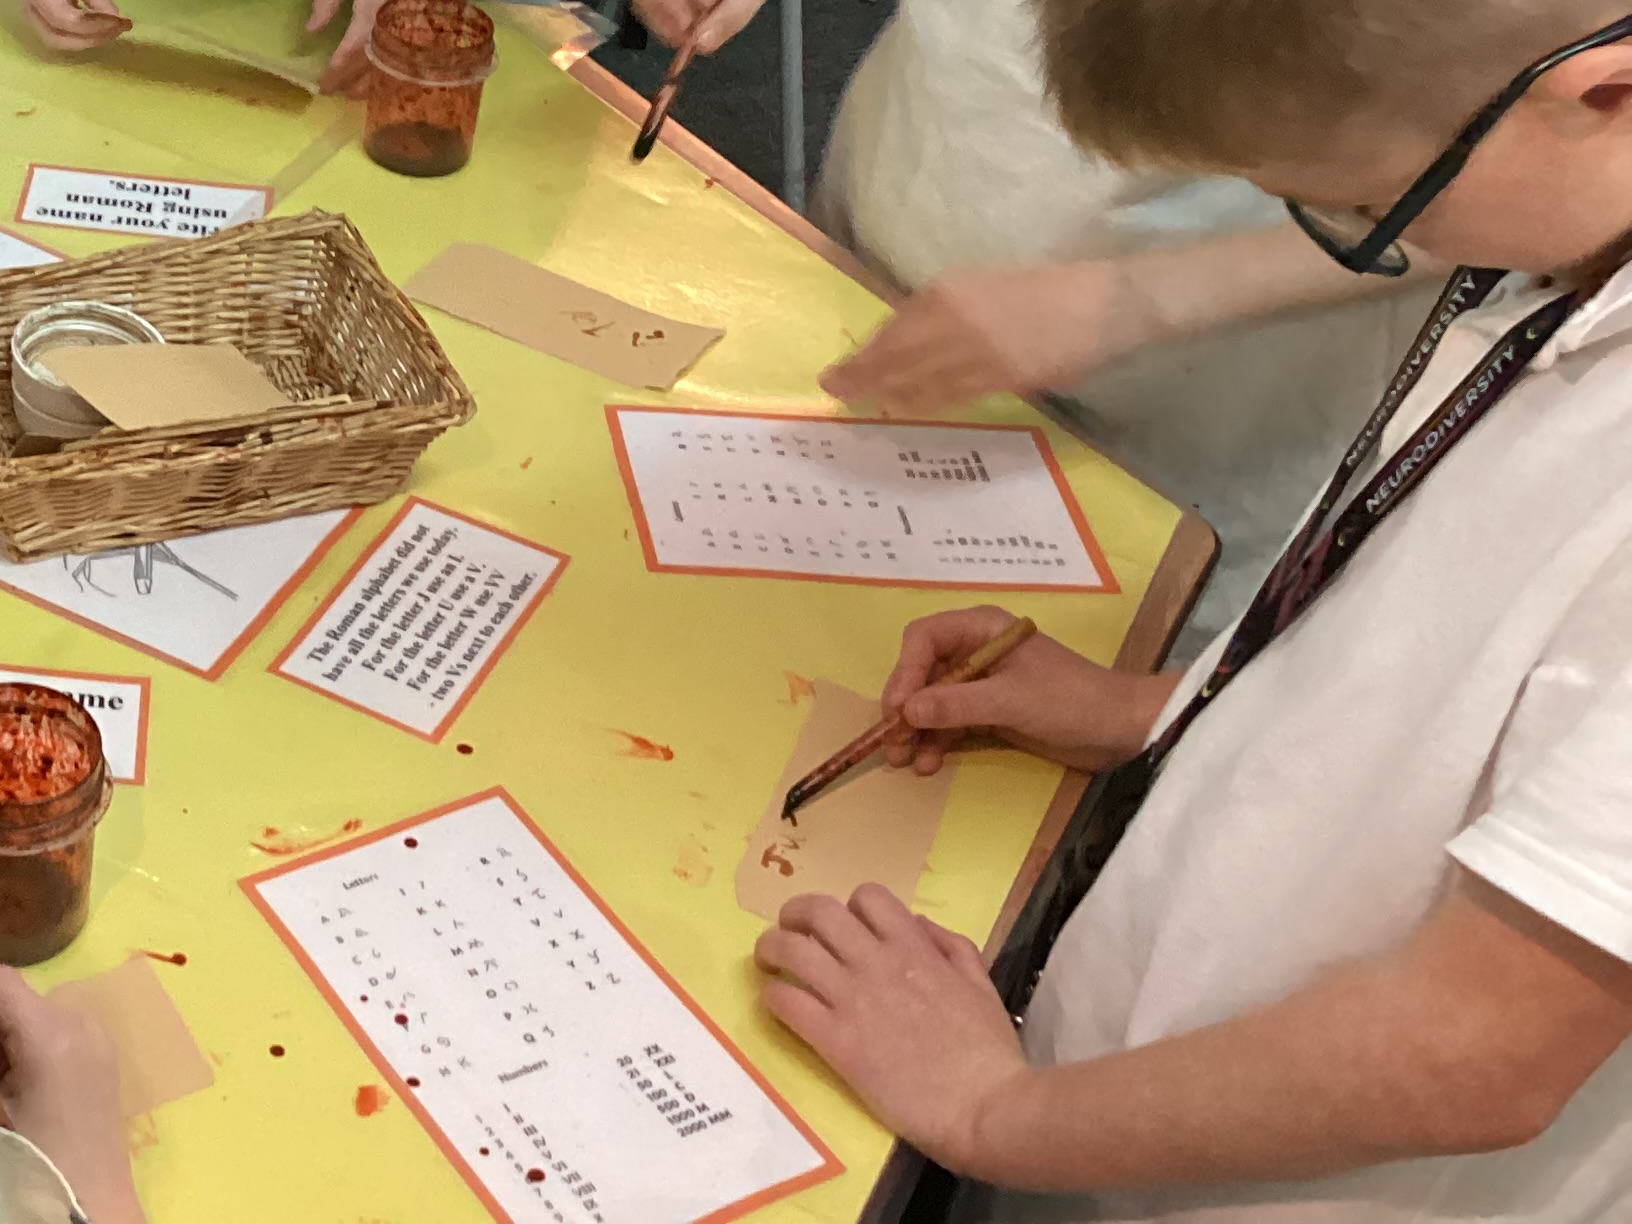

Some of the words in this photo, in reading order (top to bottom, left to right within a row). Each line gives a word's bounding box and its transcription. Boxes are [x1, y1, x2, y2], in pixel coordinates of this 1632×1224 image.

[109, 179, 191, 201] letters.
[66, 193, 153, 214] Roman
[162, 201, 227, 219] using
[35, 207, 103, 223] name
[110, 215, 170, 230] your
[177, 222, 221, 240] rite
[1366, 345, 1516, 513] NEURODIVERSITY
[447, 553, 465, 564] I.
[465, 562, 487, 574] V.
[440, 562, 458, 577] an
[464, 575, 477, 584] a
[483, 568, 506, 589] VV
[306, 641, 335, 663] The
[324, 601, 367, 642] Roman
[360, 557, 403, 603] alphabet
[394, 540, 417, 559] did
[410, 523, 431, 543] not
[425, 575, 446, 595] use
[449, 583, 470, 601] use
[321, 655, 353, 683] have
[347, 637, 366, 657] all
[357, 621, 380, 641] the
[369, 587, 407, 623] letters
[400, 572, 419, 588] we
[413, 555, 433, 573] use
[425, 527, 459, 557] today,
[416, 591, 431, 603] J
[437, 598, 455, 612] U
[474, 589, 495, 608] use
[392, 600, 424, 632] letter
[458, 605, 479, 620] W
[414, 610, 447, 642] letter
[436, 619, 469, 652] letter
[379, 631, 402, 651] the
[430, 679, 456, 701] two
[444, 662, 468, 677] Vs
[462, 636, 487, 663] next
[478, 625, 496, 638] to
[489, 601, 515, 626] each
[508, 572, 538, 602] other.
[401, 640, 425, 660] the
[424, 650, 447, 670] the
[360, 649, 387, 672] For
[383, 658, 409, 682] For
[405, 668, 431, 692] For
[497, 1059, 549, 1084] Numbers
[616, 1055, 633, 1068] 20
[676, 1119, 708, 1138] 2000
